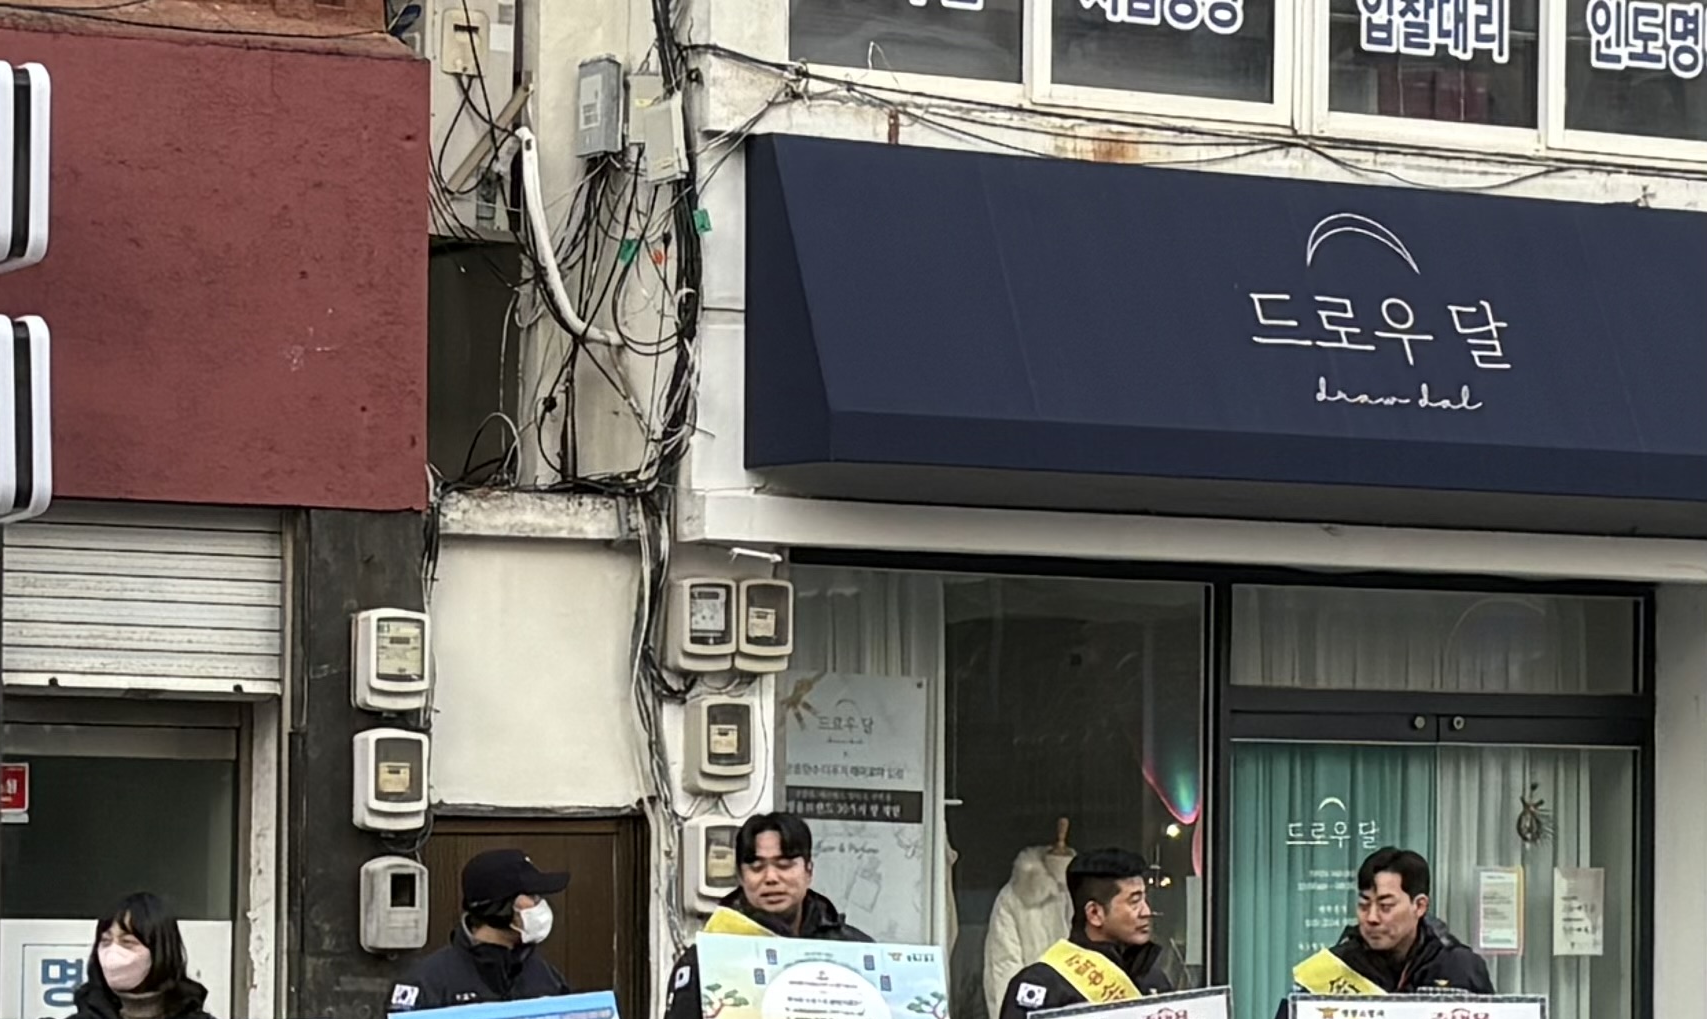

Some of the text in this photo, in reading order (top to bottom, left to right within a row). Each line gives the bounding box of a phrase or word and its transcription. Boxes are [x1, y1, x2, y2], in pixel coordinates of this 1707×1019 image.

[1589, 0, 1707, 76] 인도명
[1250, 292, 1512, 369] 드로우 달
[1285, 819, 1381, 849] 드로우 달
